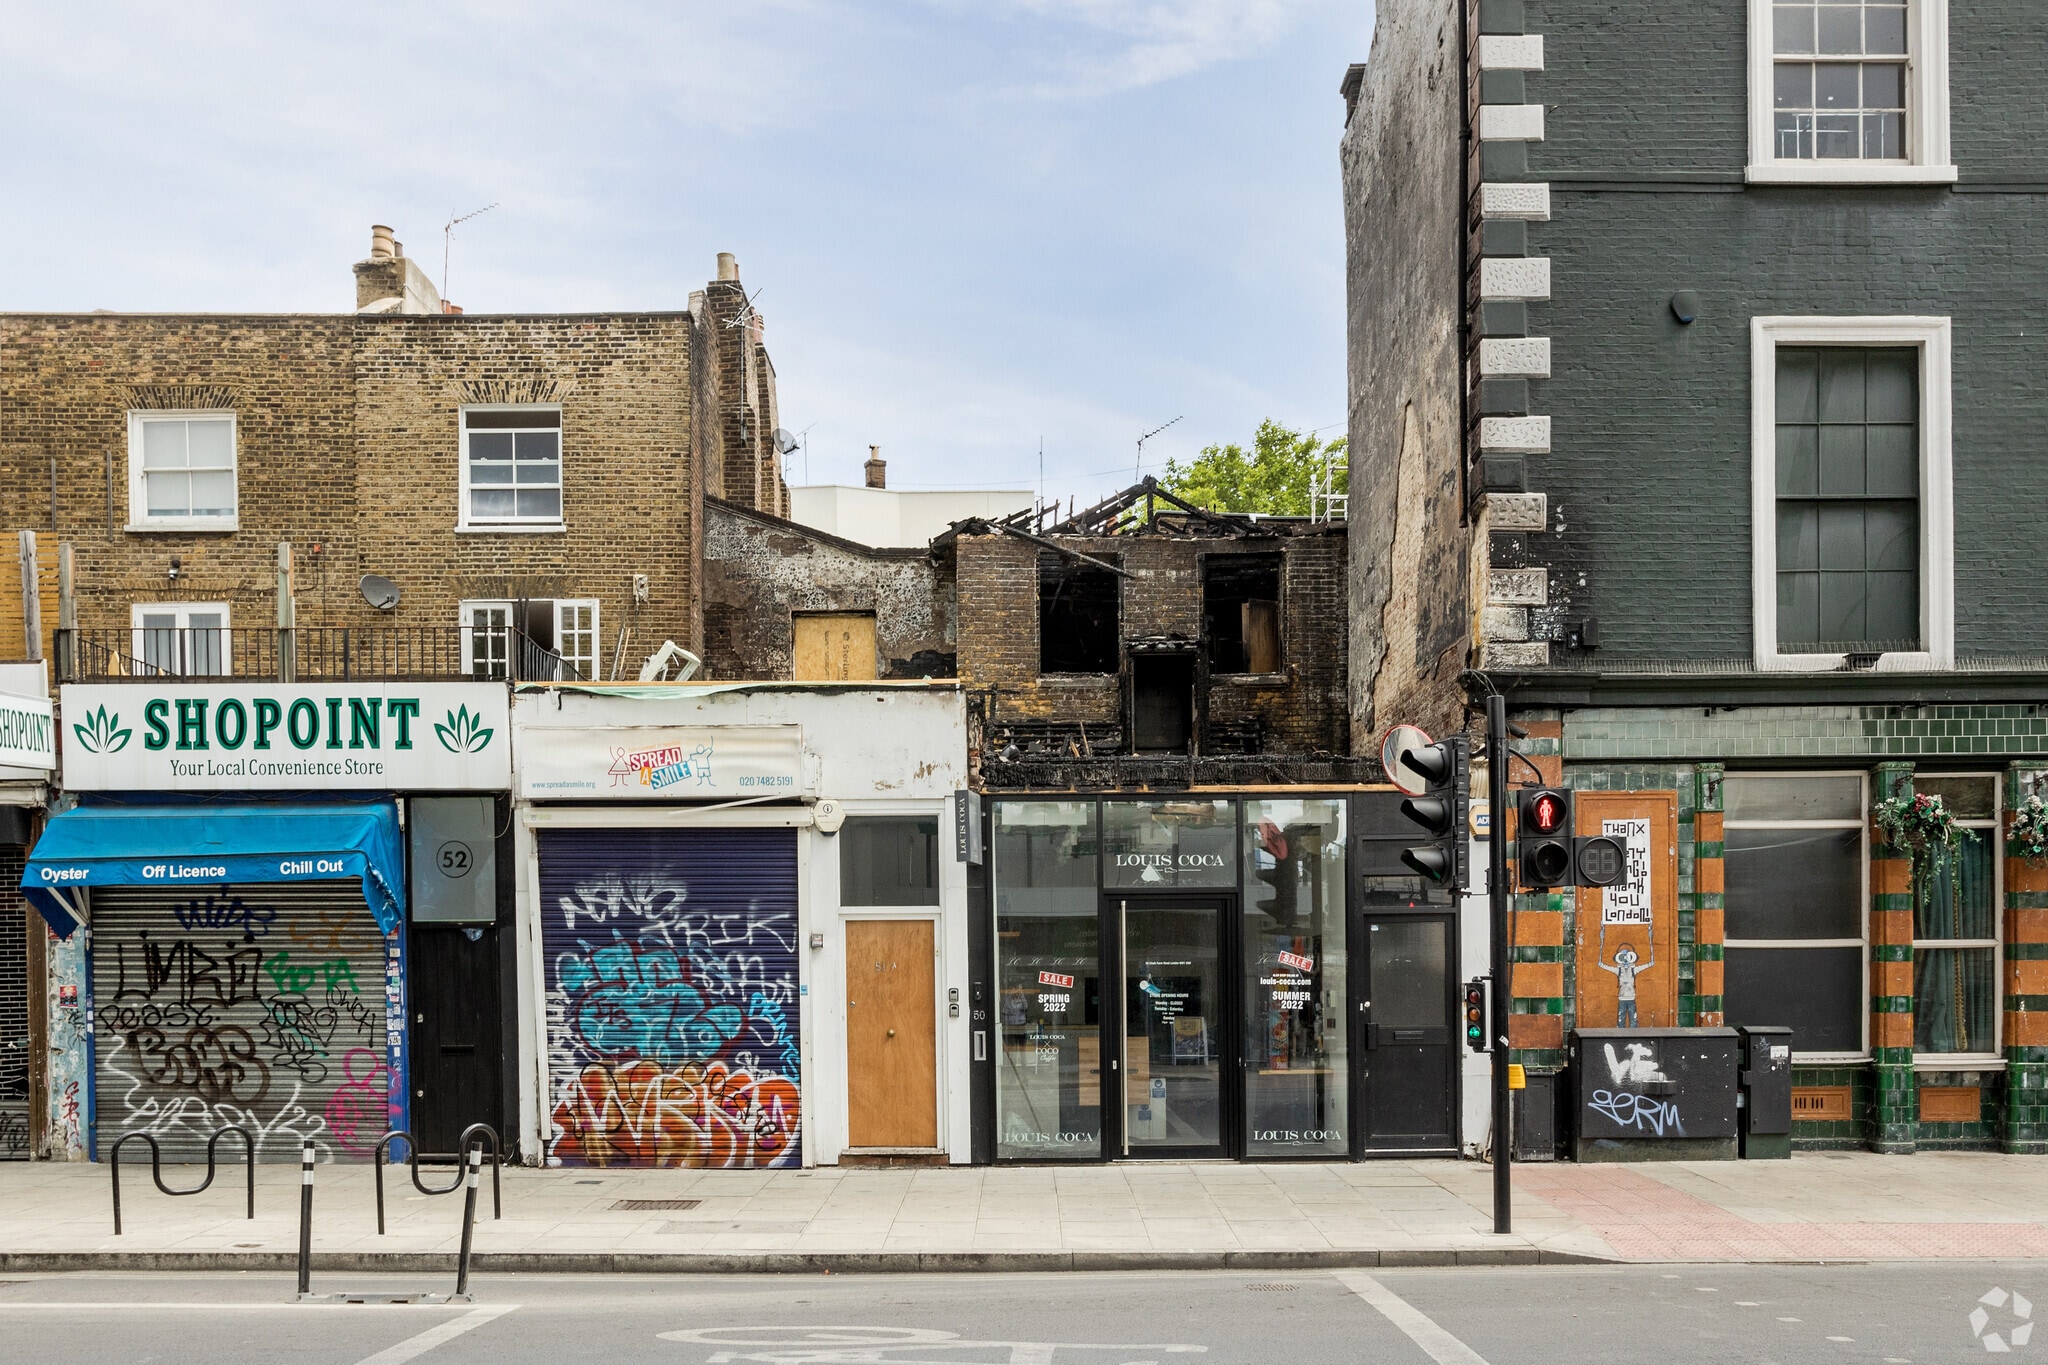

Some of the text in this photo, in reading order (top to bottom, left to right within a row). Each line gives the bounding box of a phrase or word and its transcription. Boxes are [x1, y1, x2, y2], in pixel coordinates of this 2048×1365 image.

[144, 698, 420, 751] SHOPOINT
[630, 748, 682, 771] SPREAD
[170, 759, 383, 777] Your Local Convenience Store
[641, 762, 691, 789] A SMILE
[740, 776, 793, 786] 020 7482 5191
[1477, 816, 1489, 825] AD
[443, 851, 467, 869] 52
[1116, 854, 1224, 866] LOUIS COCA
[142, 865, 226, 879] Off Licence
[280, 860, 344, 875] Chill Out
[40, 867, 89, 884] Oyster
[1283, 954, 1307, 968] SALE
[1043, 973, 1068, 985] SALE
[1260, 977, 1311, 985] louis-coca.com
[1038, 993, 1070, 1003] SPRING
[1272, 991, 1311, 1000] SUMMER
[1043, 1003, 1066, 1012] 2022
[1281, 1001, 1303, 1009] 2022
[973, 1010, 985, 1020] 50
[1005, 1132, 1093, 1142] LOUIS COCA
[1254, 1130, 1342, 1140] LOUIS COCA
